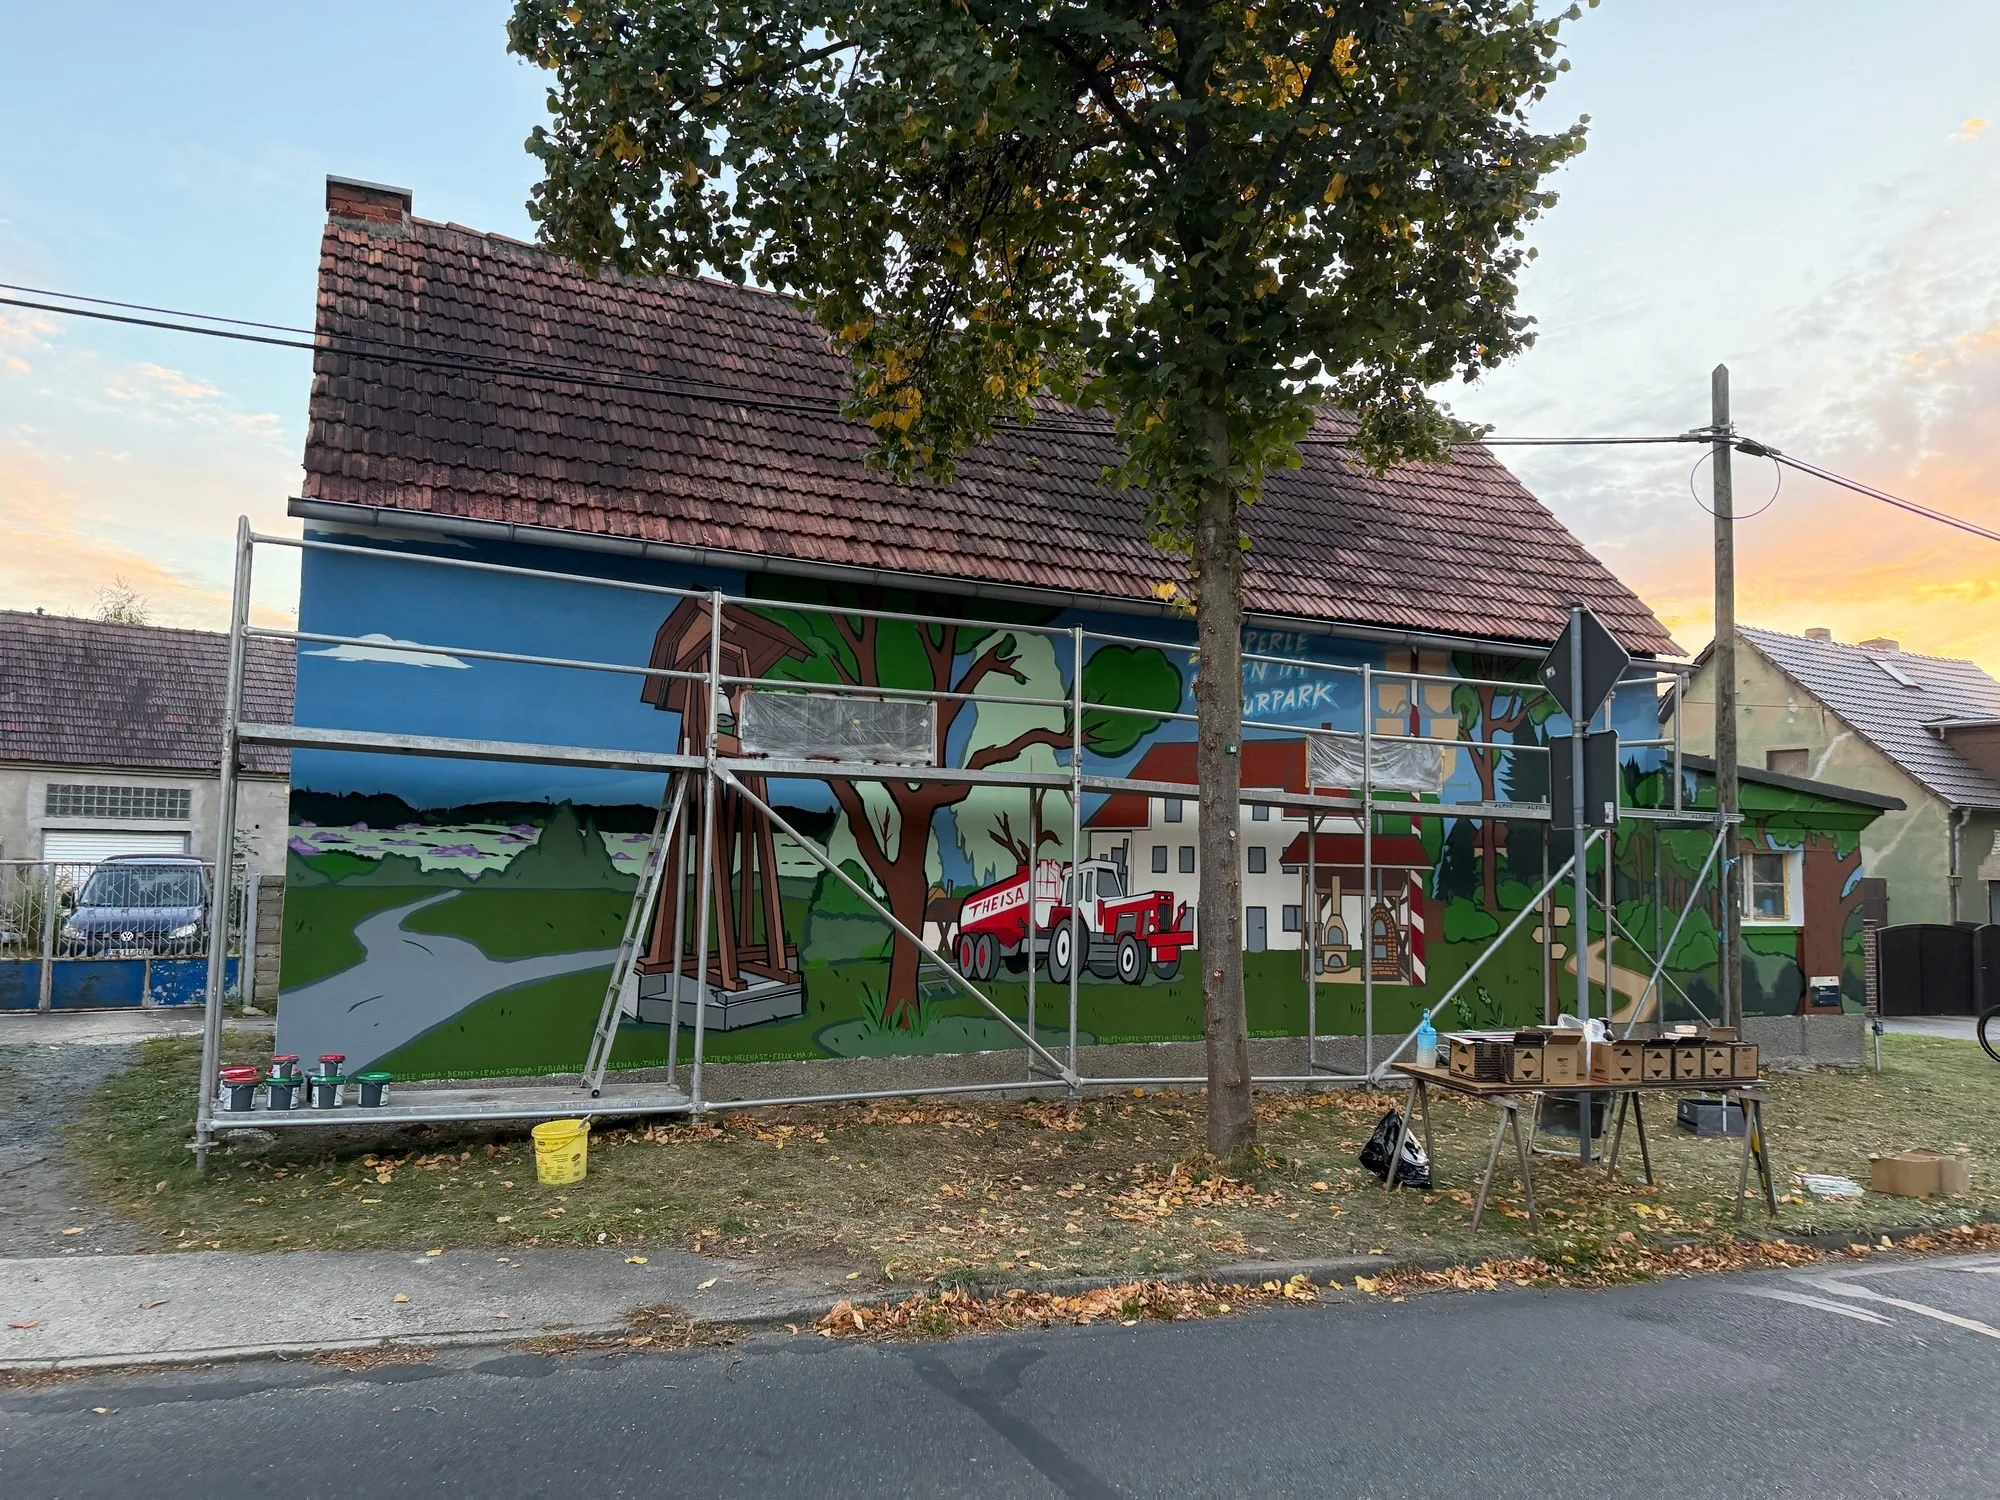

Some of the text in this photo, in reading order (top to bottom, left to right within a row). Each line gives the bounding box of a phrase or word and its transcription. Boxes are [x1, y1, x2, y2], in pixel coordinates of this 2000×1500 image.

[1244, 630, 1306, 653] PERLE
[969, 887, 1024, 918] THEISA
[447, 1070, 475, 1078] BENNY
[538, 1064, 568, 1073] FABIAN
[773, 1052, 792, 1060] FELIX
